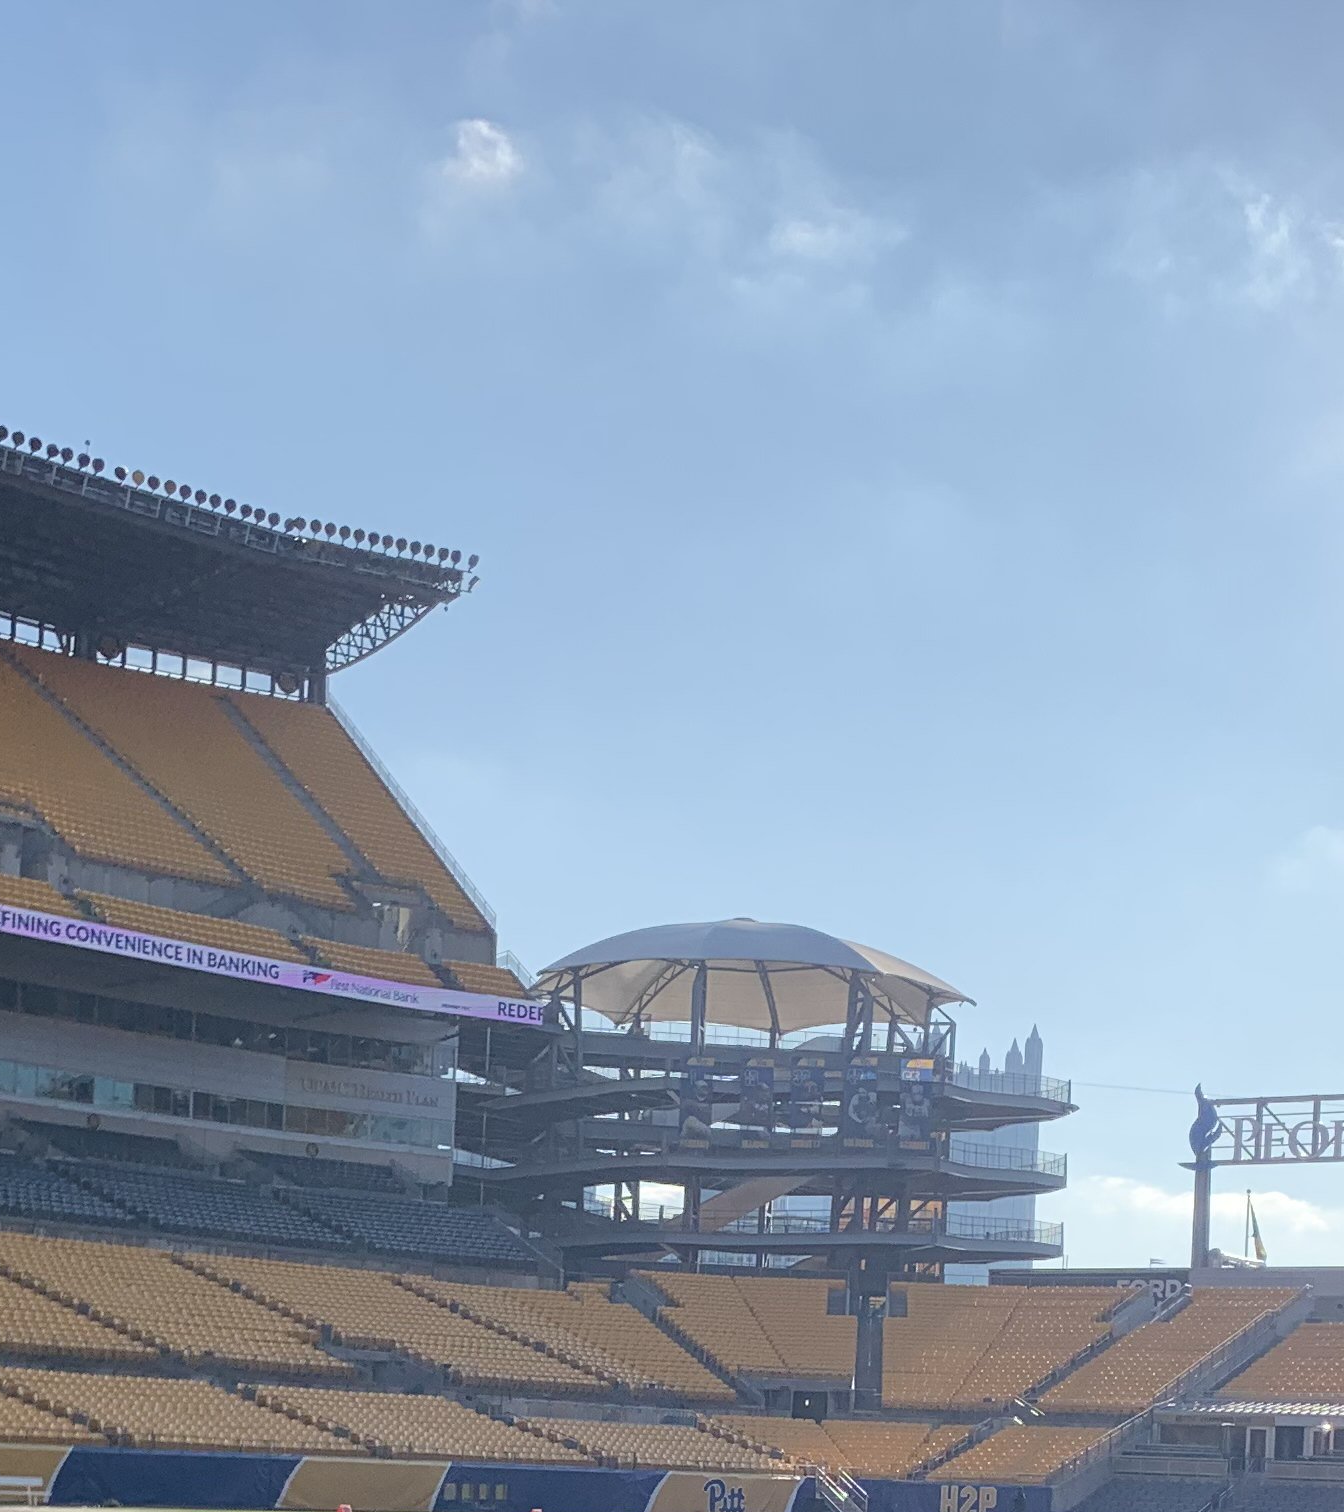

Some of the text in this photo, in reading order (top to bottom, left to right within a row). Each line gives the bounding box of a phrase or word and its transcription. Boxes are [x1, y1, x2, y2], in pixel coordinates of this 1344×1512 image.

[66, 923, 183, 962] CONVENIENCE
[187, 948, 204, 965] IN
[208, 952, 280, 980] BANKING
[394, 991, 420, 1004] Bank
